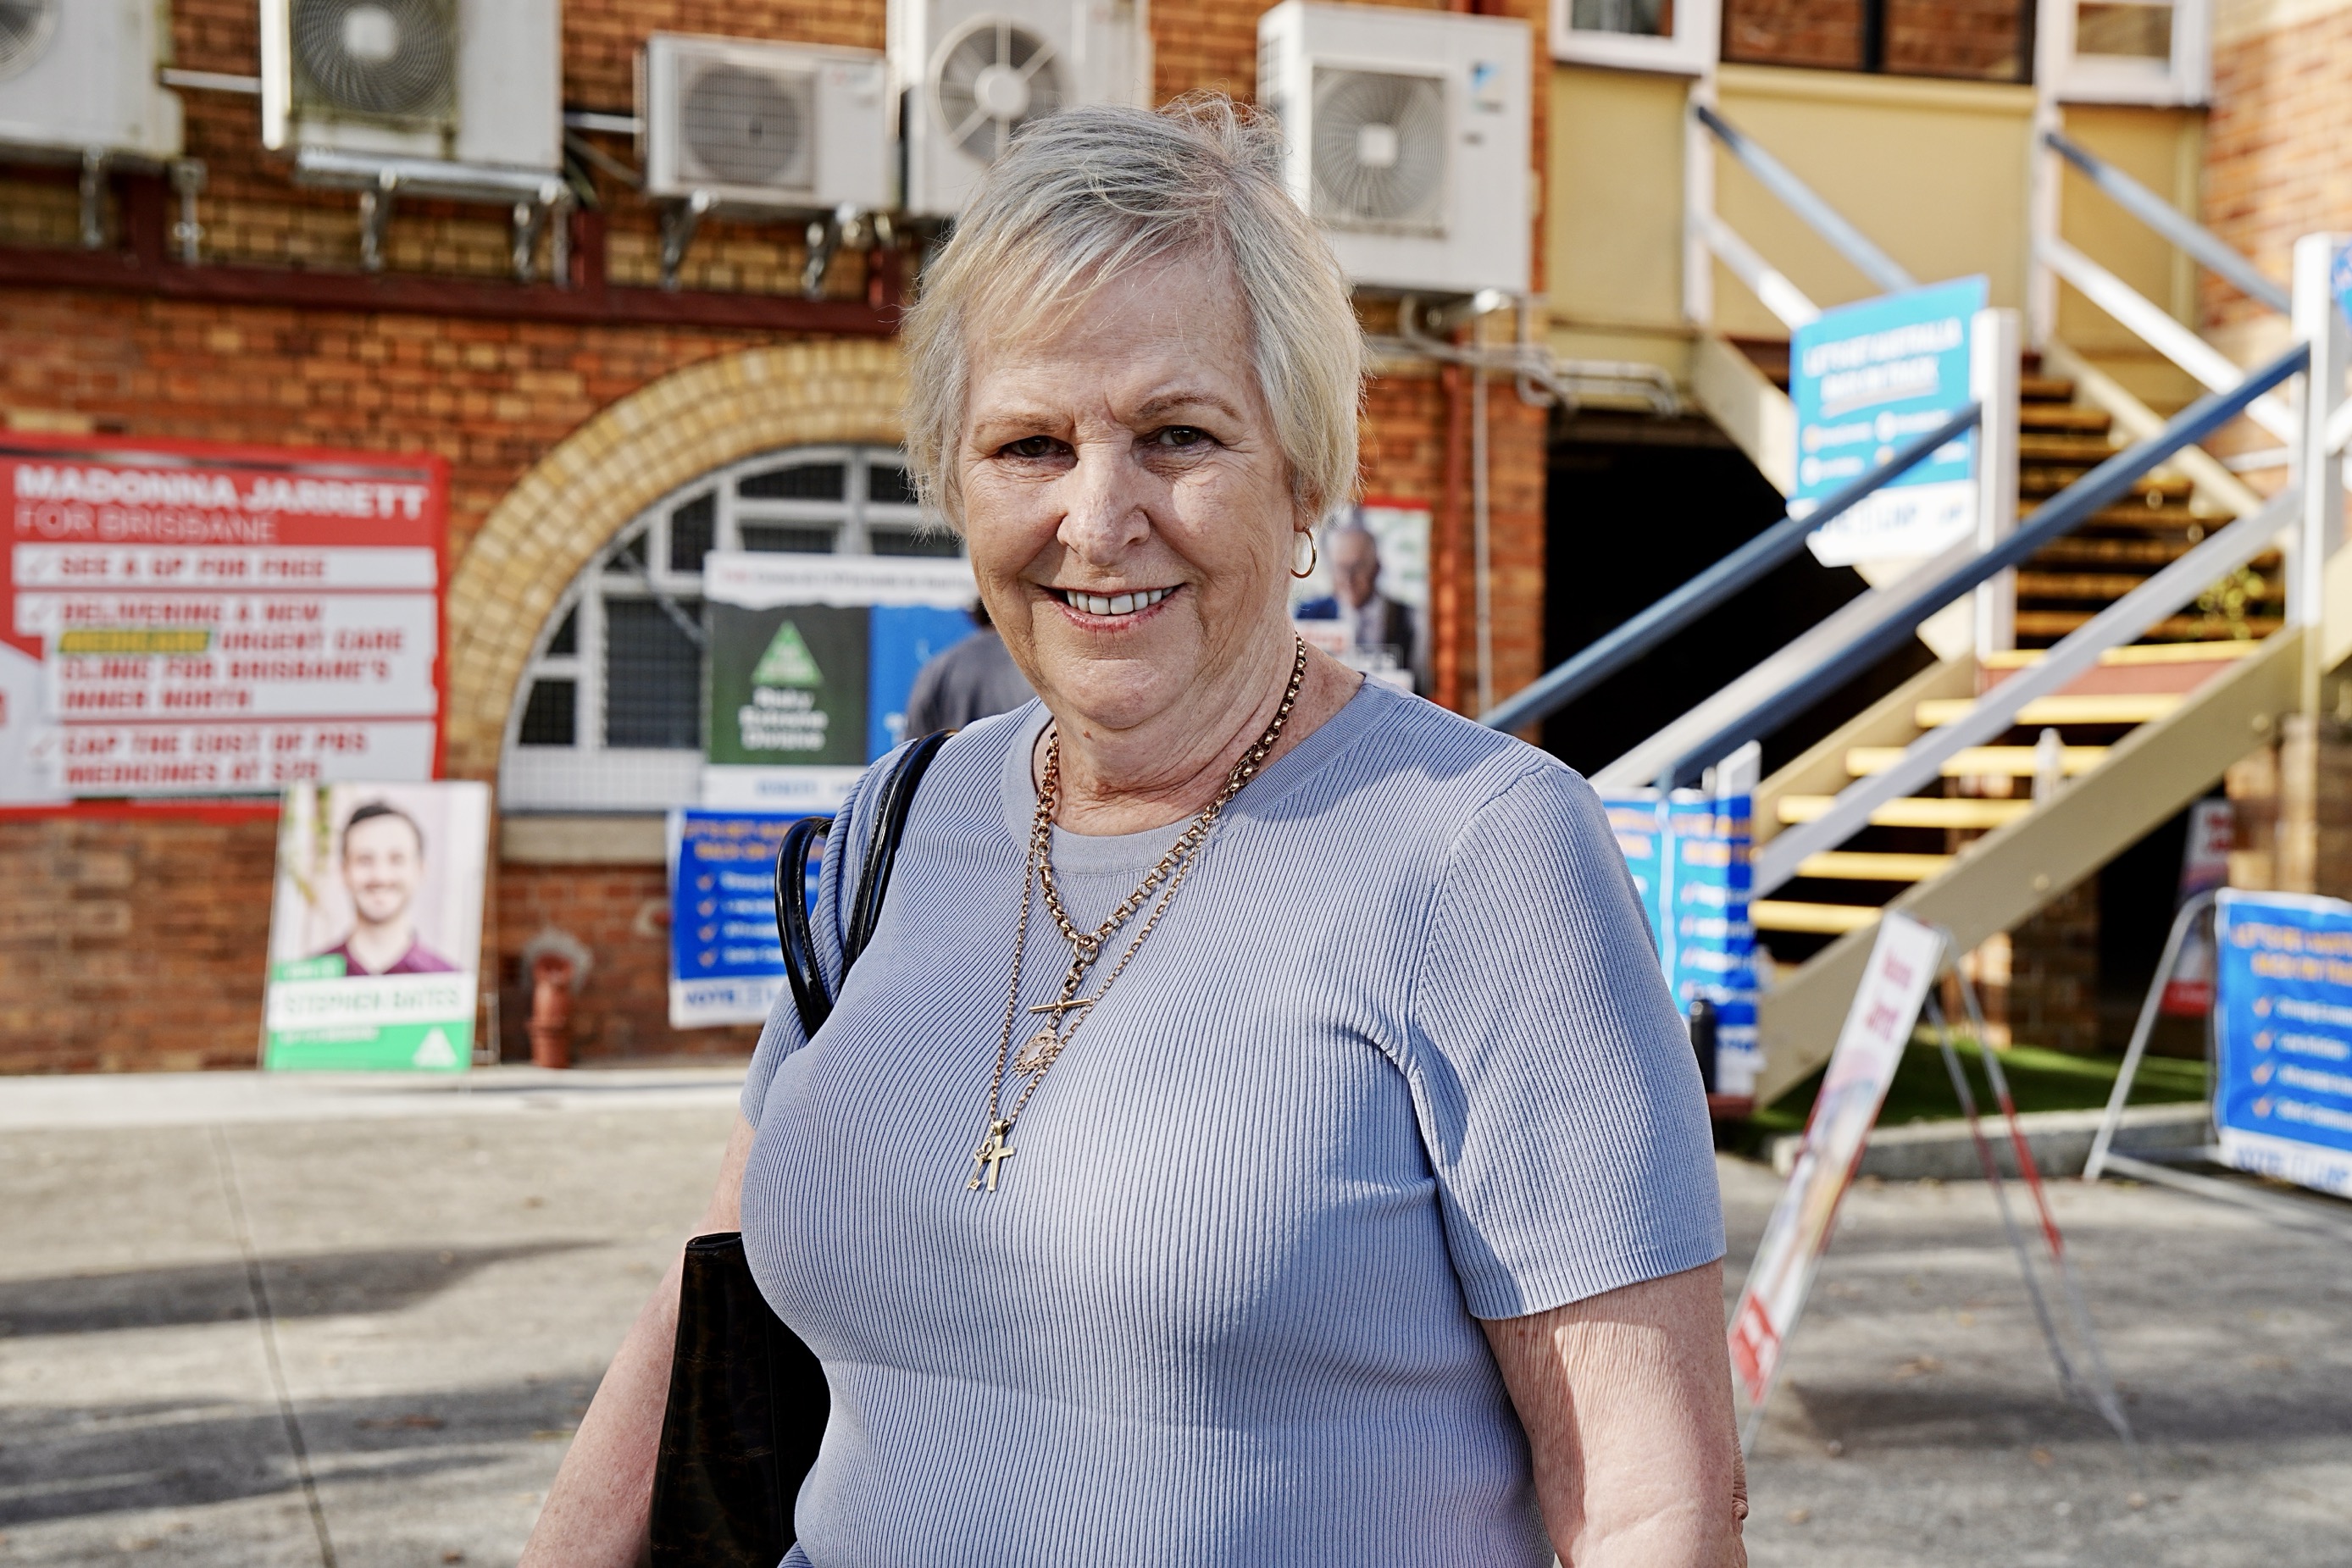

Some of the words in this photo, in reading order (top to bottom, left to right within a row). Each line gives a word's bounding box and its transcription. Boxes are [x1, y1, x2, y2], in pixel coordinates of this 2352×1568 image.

[14, 465, 237, 508] MADONNA
[242, 477, 427, 519] JARRETT
[14, 501, 95, 538] FOR
[97, 505, 277, 544] BRISBANE
[62, 556, 109, 576] SEE
[198, 557, 247, 577] FOR
[262, 557, 325, 579] FREE
